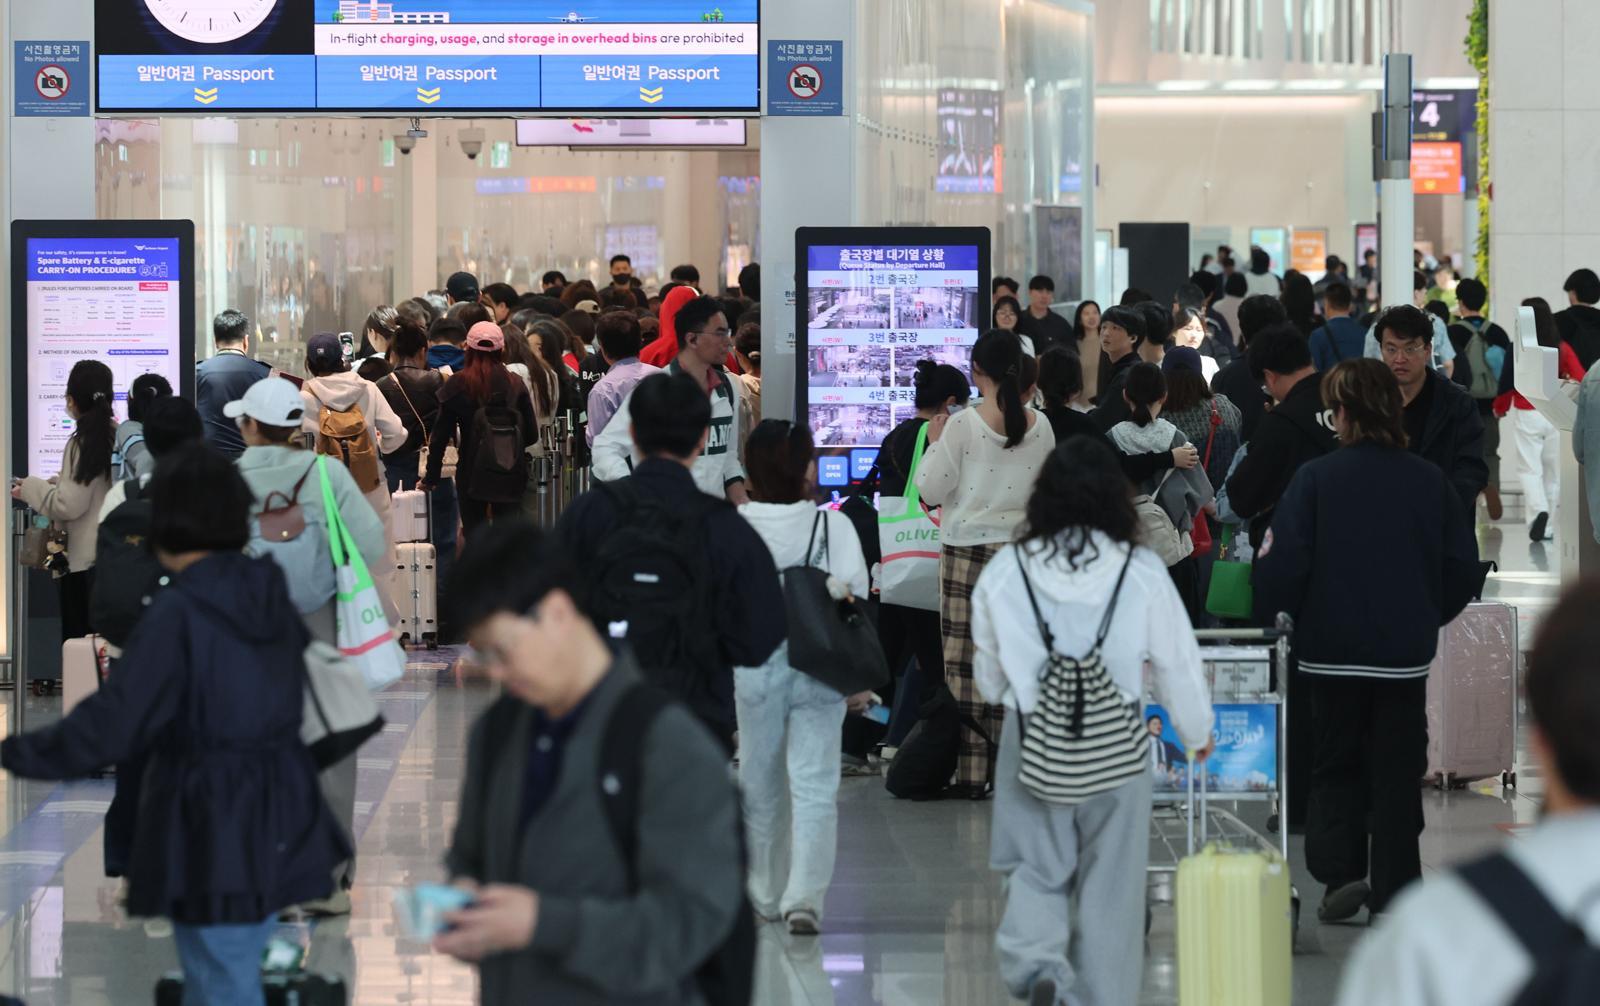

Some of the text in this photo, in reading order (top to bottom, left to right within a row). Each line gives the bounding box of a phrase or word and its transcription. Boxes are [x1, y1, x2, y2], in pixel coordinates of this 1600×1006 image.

[330, 32, 745, 46] In-flight charging, usage, and storage in overhead bins are prohibited
[24, 44, 80, 54] 사진촬영금지
[777, 44, 832, 54] 사진촬영금지
[137, 65, 274, 83] 일반여권 Passport
[360, 65, 498, 82] 일반여권 Passport
[582, 64, 720, 82] 일반여권 Passport
[1420, 102, 1440, 128] 4
[840, 248, 945, 260] 출국장별 대기열 상황
[38, 257, 60, 265] Spare
[62, 257, 92, 265] Battery
[102, 257, 146, 265] E-cigarette
[870, 274, 918, 285] 2번 출국장
[868, 332, 918, 344] 3번 출국장
[868, 390, 885, 401] 4번
[896, 529, 940, 542] OLIVE
